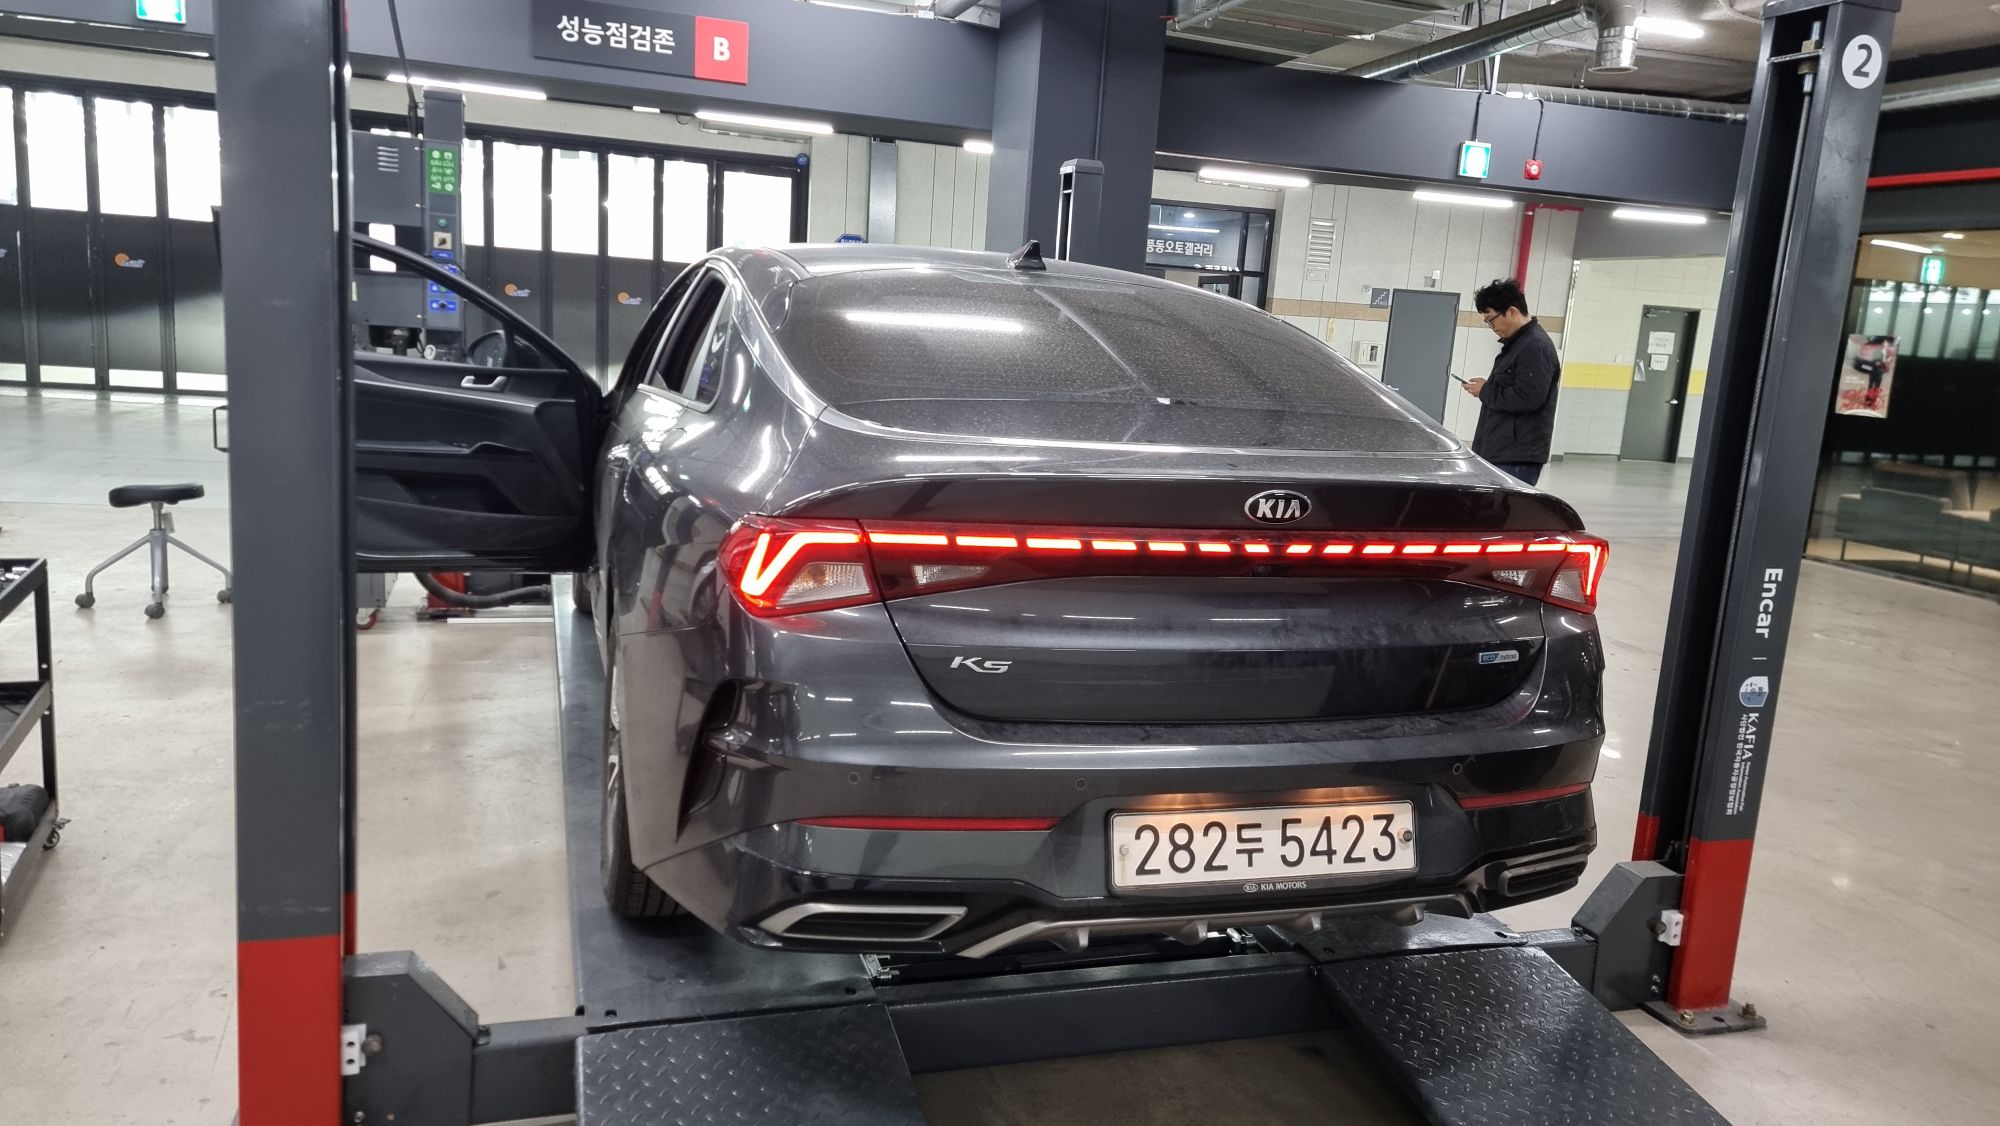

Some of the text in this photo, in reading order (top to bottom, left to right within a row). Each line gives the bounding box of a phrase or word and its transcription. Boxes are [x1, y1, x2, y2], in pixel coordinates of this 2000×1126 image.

[556, 15, 676, 55] 성능점검존
[713, 36, 731, 62] B
[1852, 43, 1873, 79] 2
[1256, 498, 1301, 519] KIA
[1755, 568, 1784, 639] Encar
[950, 656, 1013, 674] K5
[1741, 712, 1760, 760] KAFIA
[1134, 813, 1396, 876] 282두 5423
[1260, 883, 1274, 891] KIA
[1275, 881, 1307, 890] MOTORS
